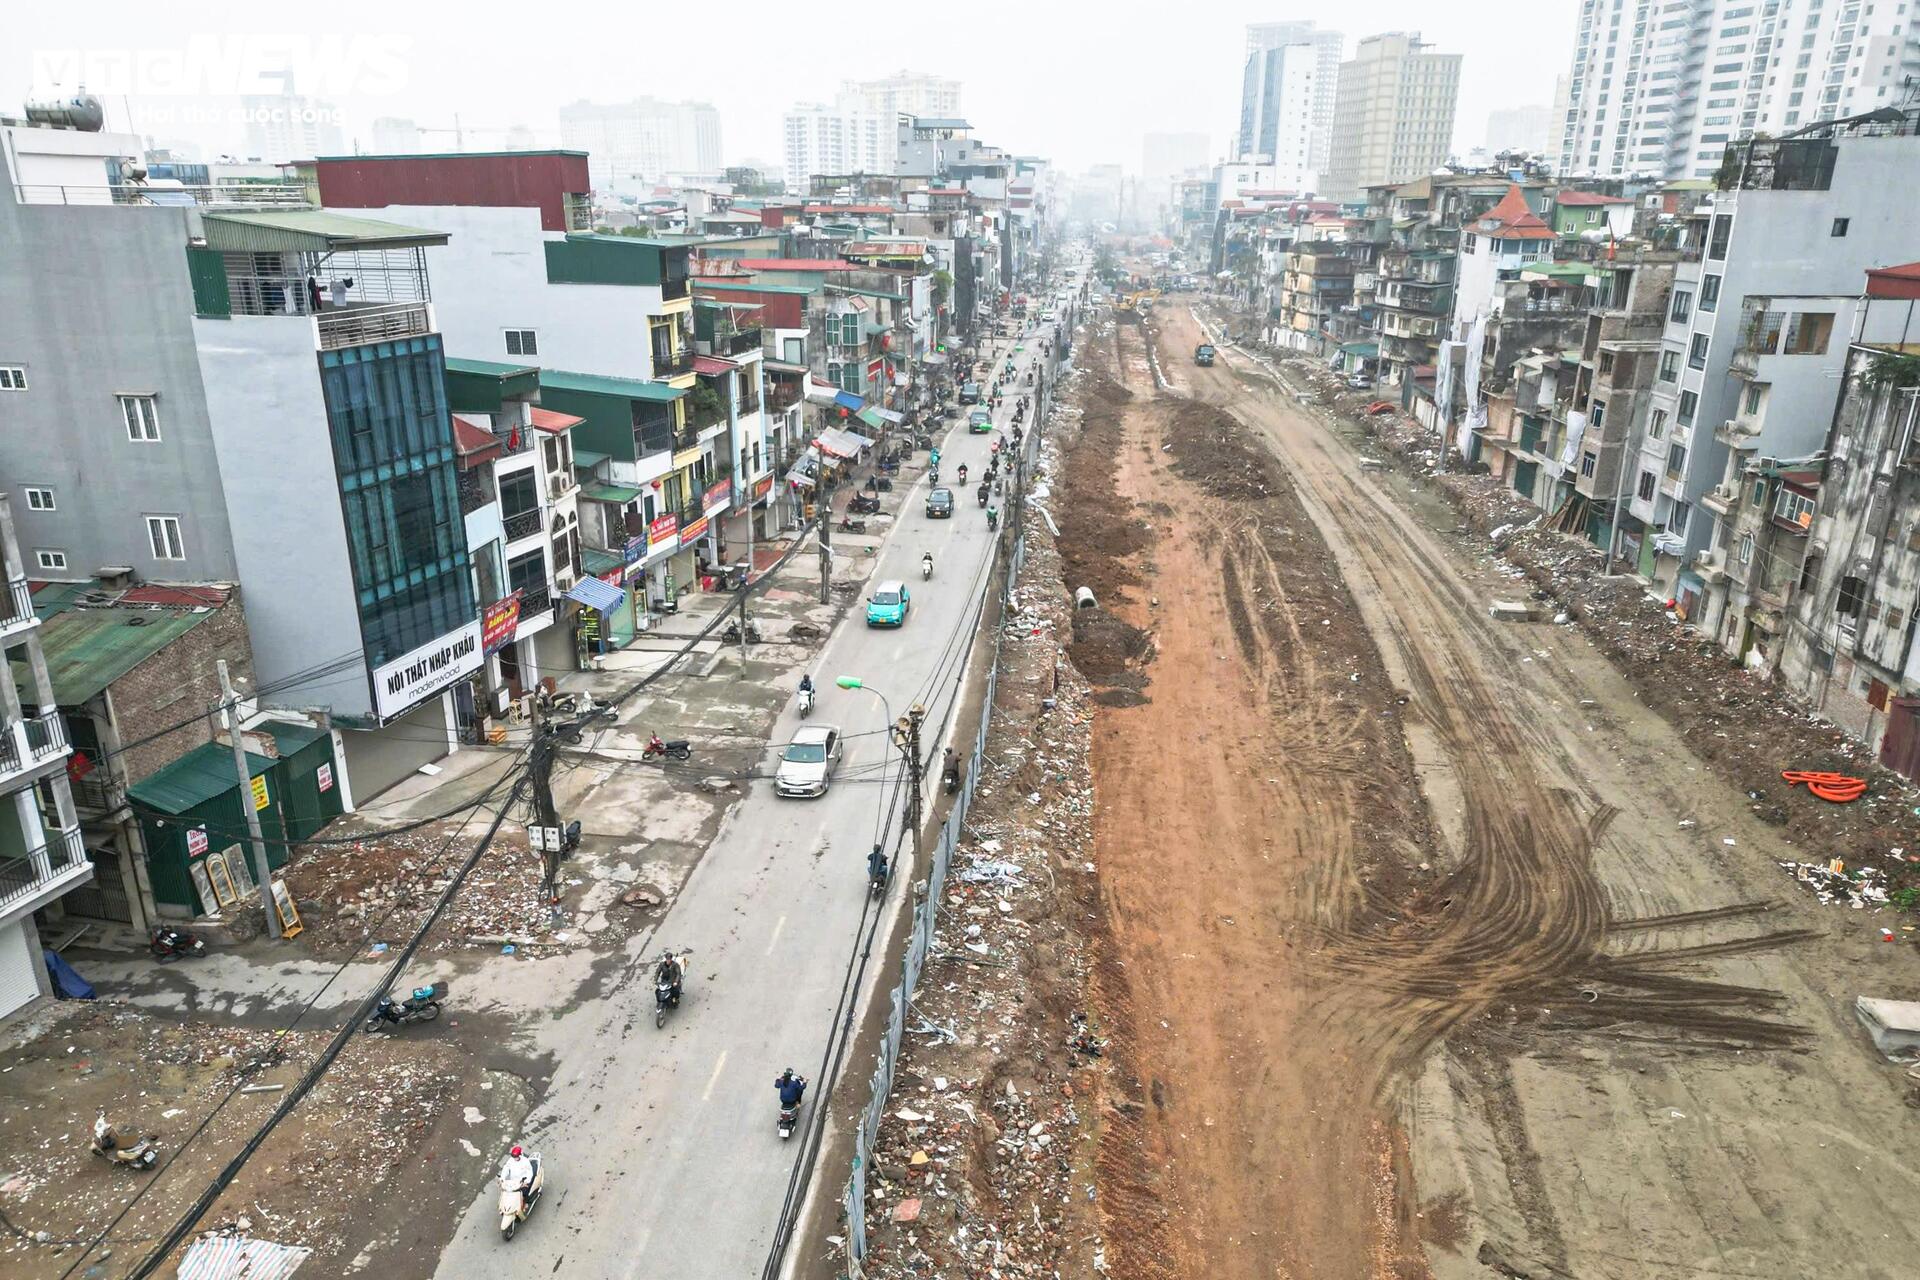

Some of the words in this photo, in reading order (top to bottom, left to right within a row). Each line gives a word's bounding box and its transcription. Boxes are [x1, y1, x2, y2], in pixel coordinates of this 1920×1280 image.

[387, 671, 405, 695] NỘI
[405, 656, 428, 685] THẤT
[429, 647, 452, 673] NHẬP
[452, 632, 475, 661] KHẨU
